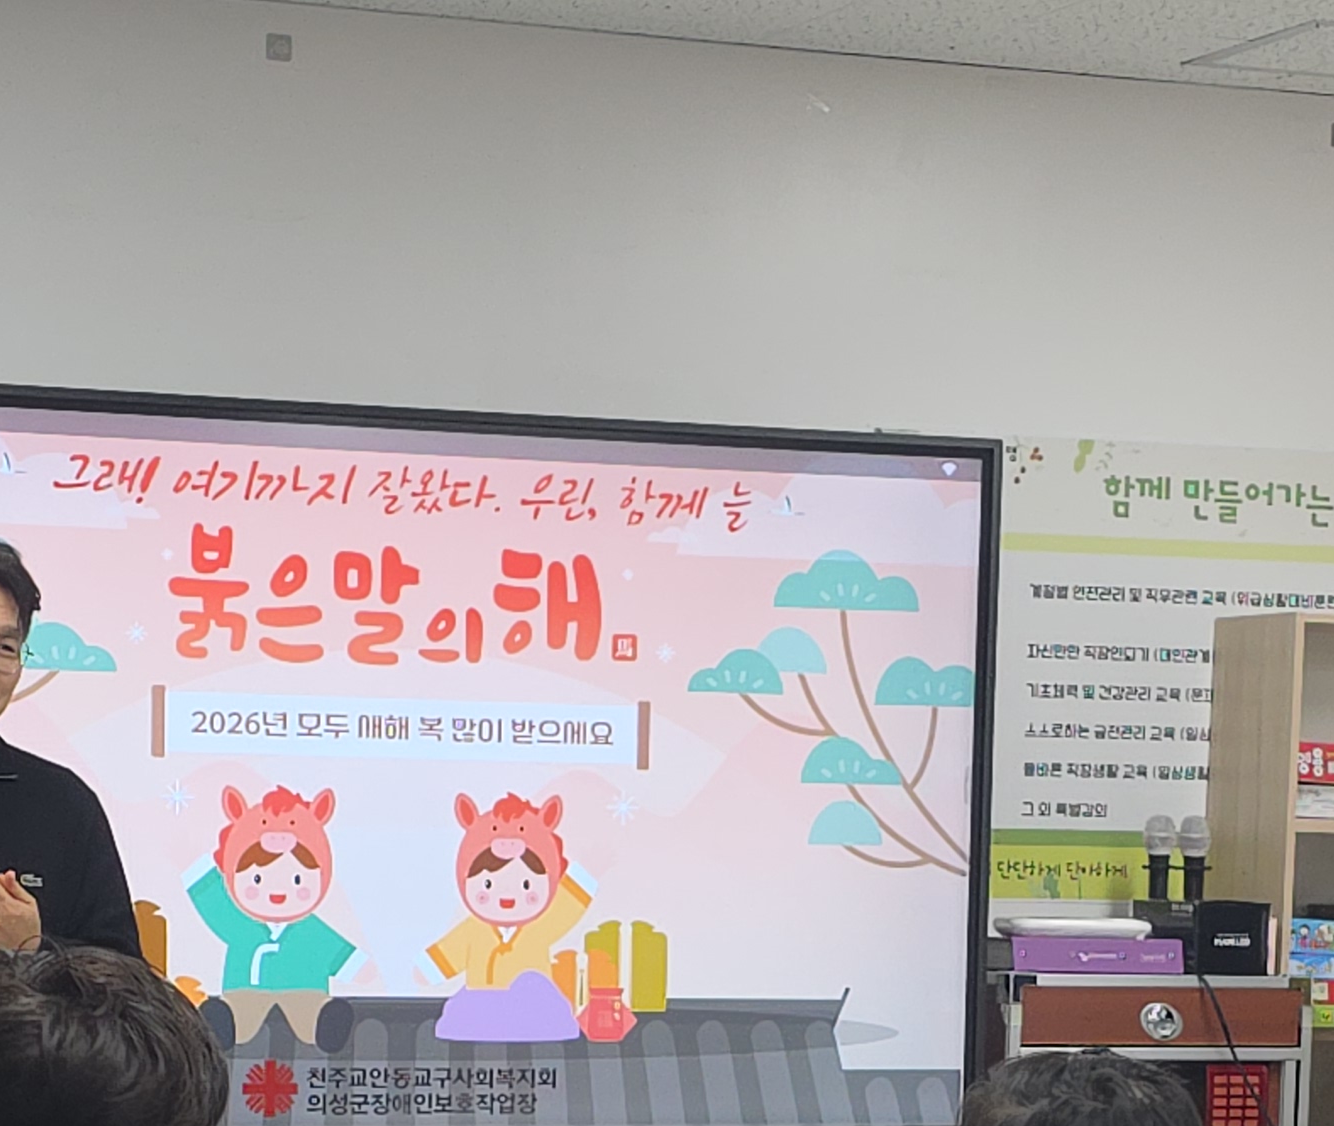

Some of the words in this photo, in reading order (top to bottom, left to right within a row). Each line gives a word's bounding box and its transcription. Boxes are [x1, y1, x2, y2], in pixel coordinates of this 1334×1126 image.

[52, 453, 162, 505] 그래!
[172, 459, 358, 506] 여기까지
[368, 465, 502, 516] 잘왔다.
[520, 472, 597, 521] 우린,
[619, 477, 709, 526] 함께
[723, 481, 752, 532] 늘
[1103, 475, 1171, 518] 함께
[1182, 478, 1334, 528] 만들어가는
[1072, 584, 1126, 602] 안전관리
[1129, 587, 1143, 603] 및
[1145, 588, 1198, 605] 직무관련
[1201, 590, 1227, 606] 교육
[1026, 682, 1079, 699] 기초체력
[1082, 684, 1095, 699] 및
[1098, 685, 1152, 701] 건강관리
[1155, 686, 1181, 702] 교육
[190, 710, 289, 738] 2026년
[295, 711, 350, 739] 모두
[357, 713, 410, 741] 새해
[417, 716, 444, 742] 복
[452, 717, 504, 744] 많이
[511, 718, 614, 747] 받으세요
[1024, 722, 1090, 739] 스스로하는
[1149, 725, 1175, 742] 교육
[1122, 764, 1148, 779] 교육
[1021, 801, 1035, 817] 그
[1055, 803, 1108, 818] 특별강의
[997, 859, 1062, 880] 단단하게
[306, 1066, 557, 1090] 천주교안동교구사회복지회
[306, 1092, 538, 1116] 의성군장애인보호작업장
